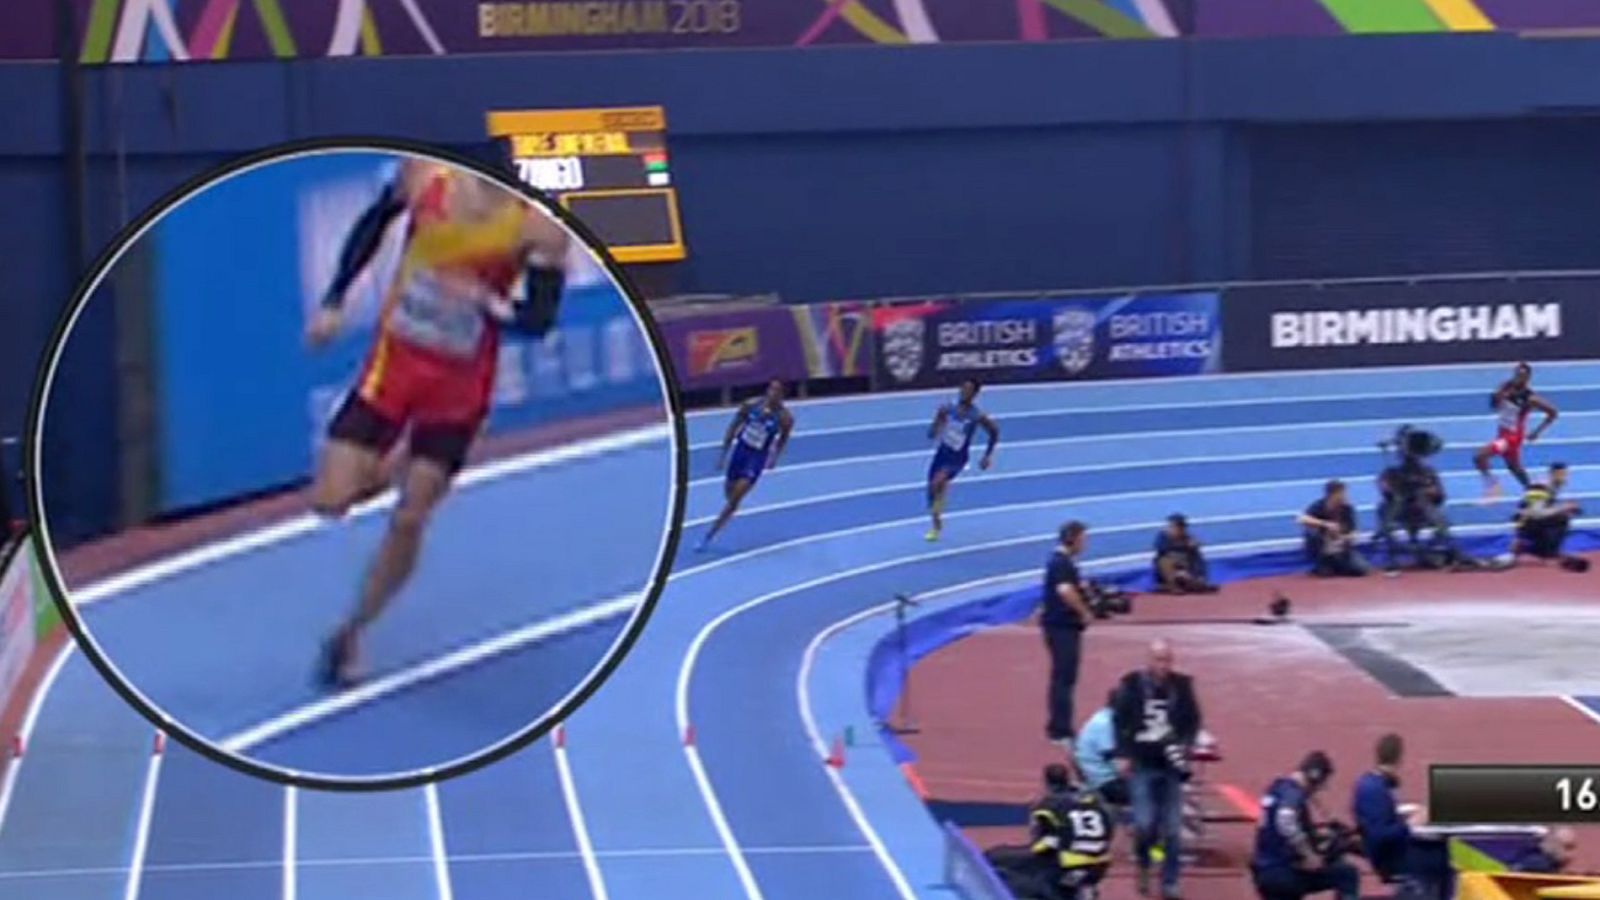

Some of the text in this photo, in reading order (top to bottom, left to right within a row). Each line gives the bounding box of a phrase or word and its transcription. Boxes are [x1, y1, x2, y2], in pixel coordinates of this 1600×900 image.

[478, 0, 740, 37] BIRMINGHAM 2018
[937, 320, 1036, 347] BRITISH
[1109, 311, 1209, 339] BRITISH
[1270, 303, 1562, 348] BIRMINGHAM
[936, 347, 1038, 371] ATHLETICS
[1108, 339, 1211, 362] ATHLETICS
[1068, 809, 1104, 838] 13
